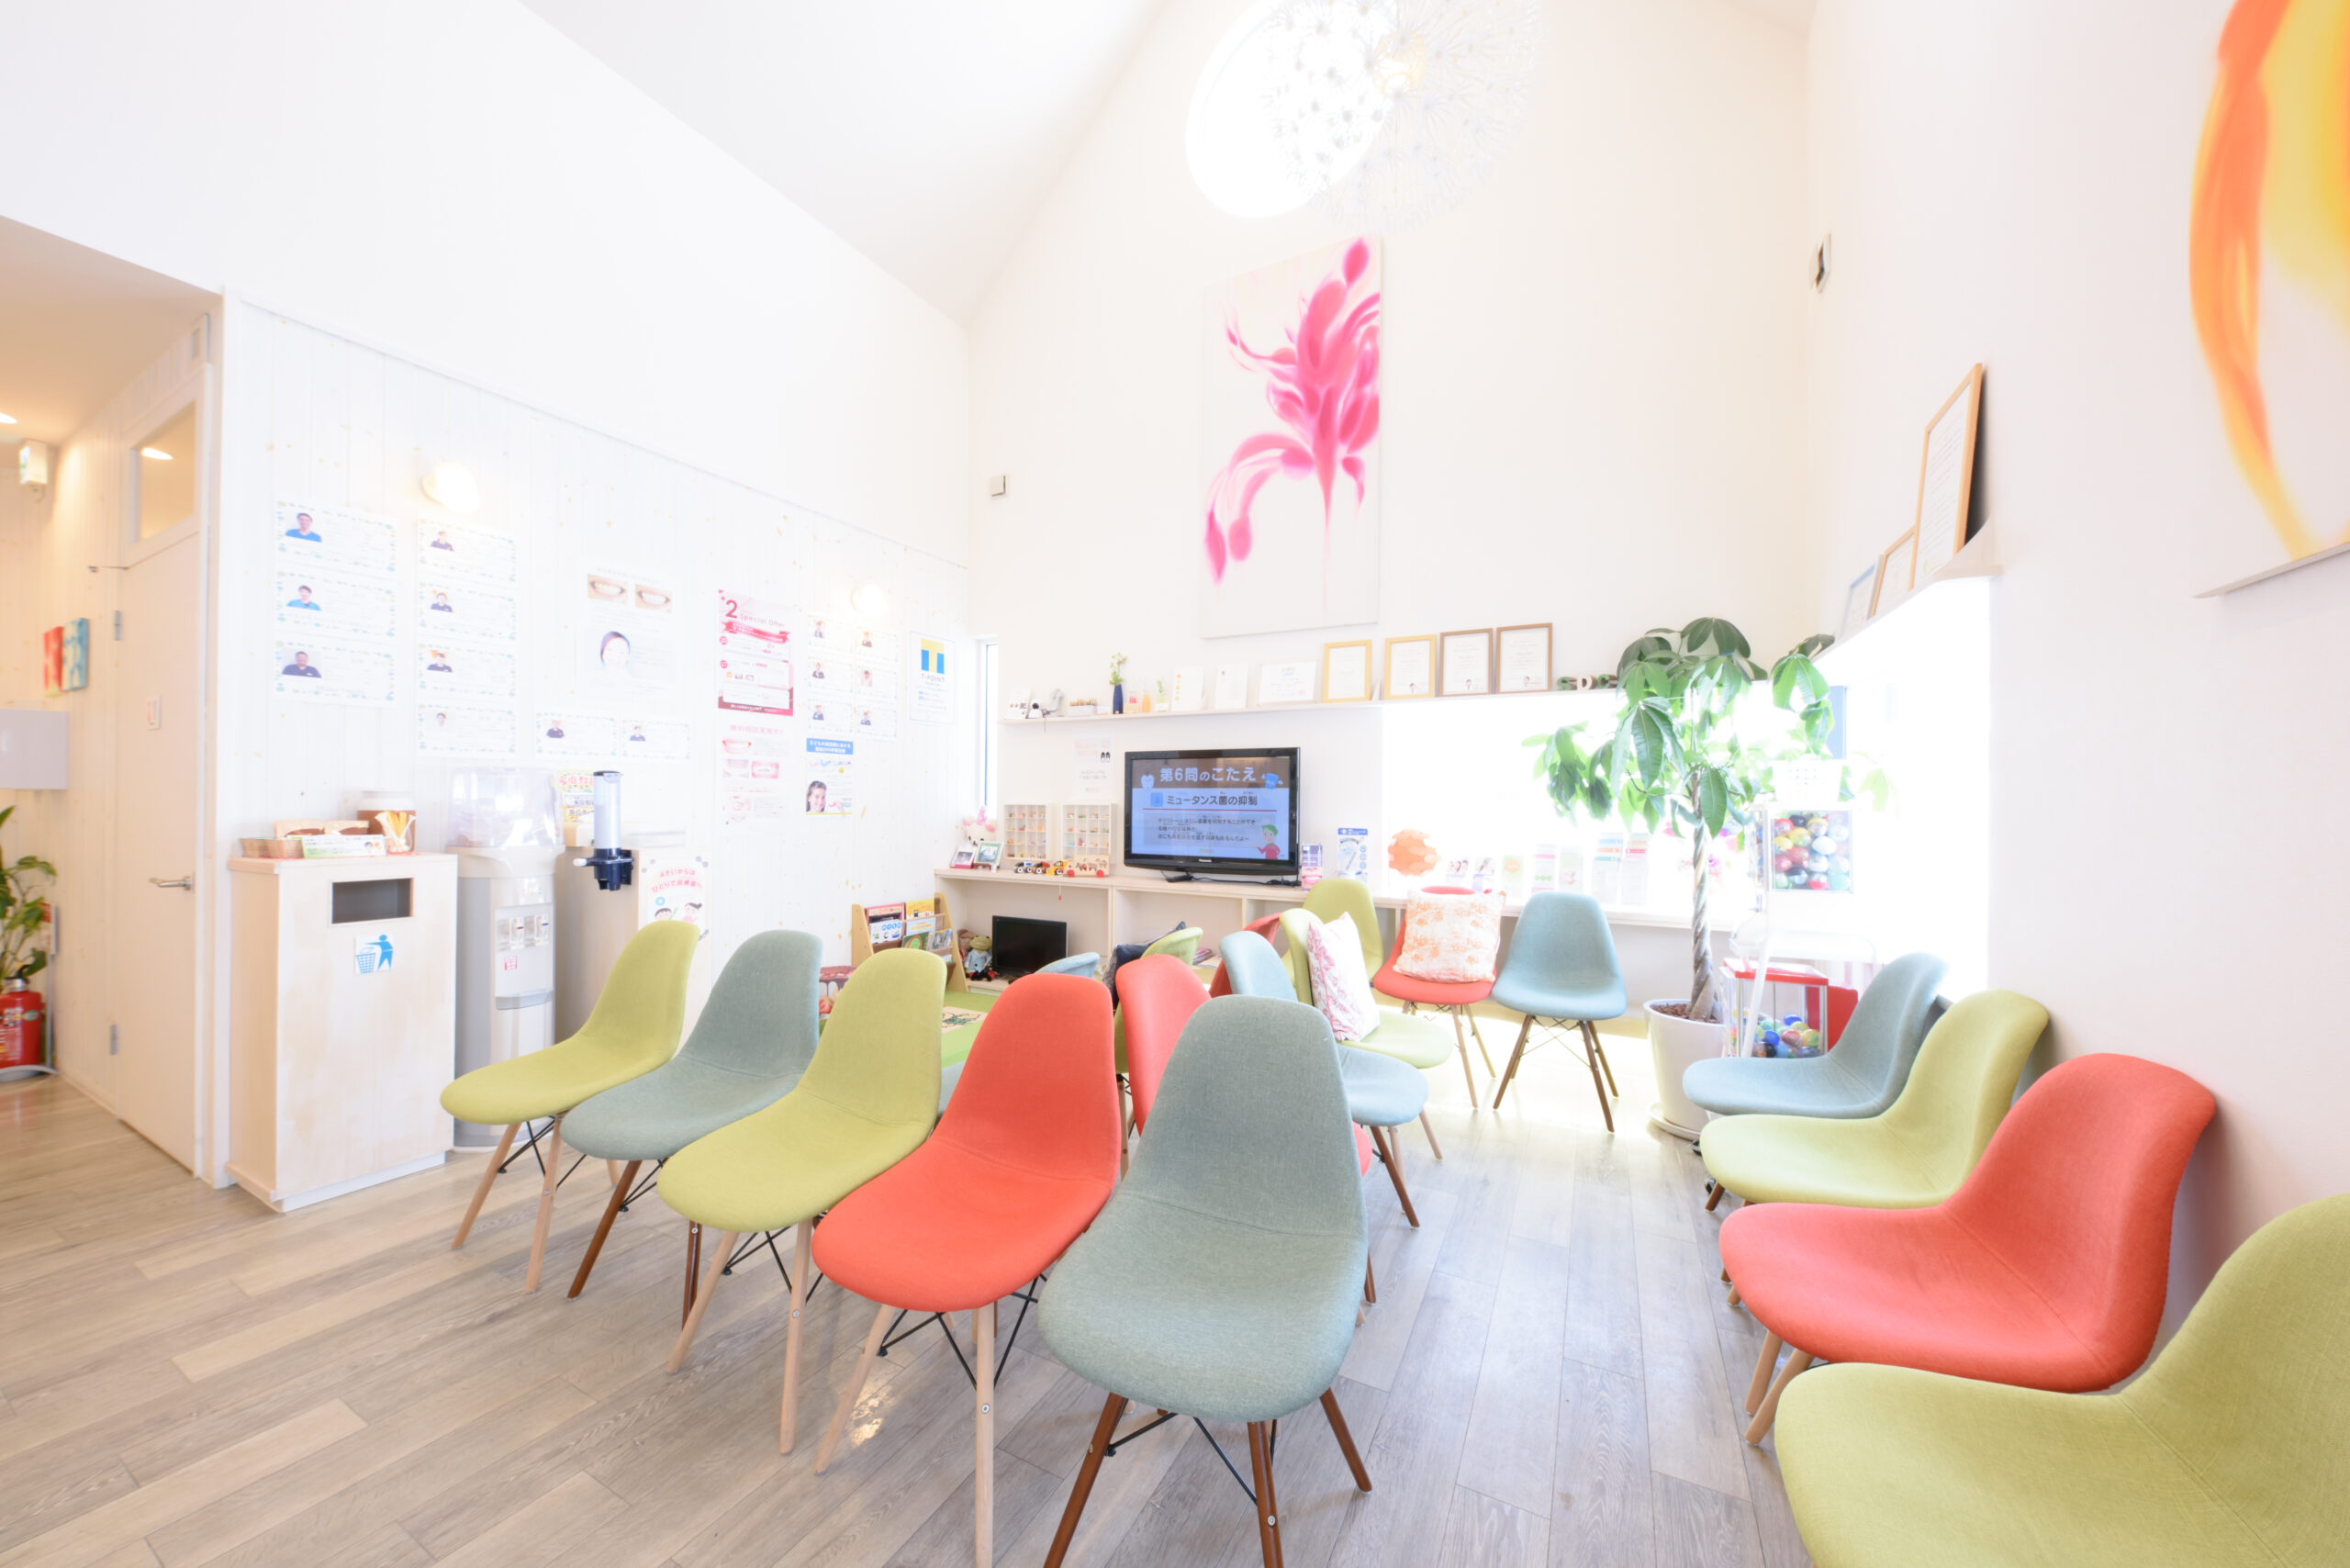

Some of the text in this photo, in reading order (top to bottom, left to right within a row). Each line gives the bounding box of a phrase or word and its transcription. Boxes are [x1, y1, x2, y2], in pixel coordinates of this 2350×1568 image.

[725, 599, 738, 618] 2
[1159, 767, 1257, 782] 第6問のこたえ
[1167, 795, 1258, 806] ミュータンス菌の抑制
